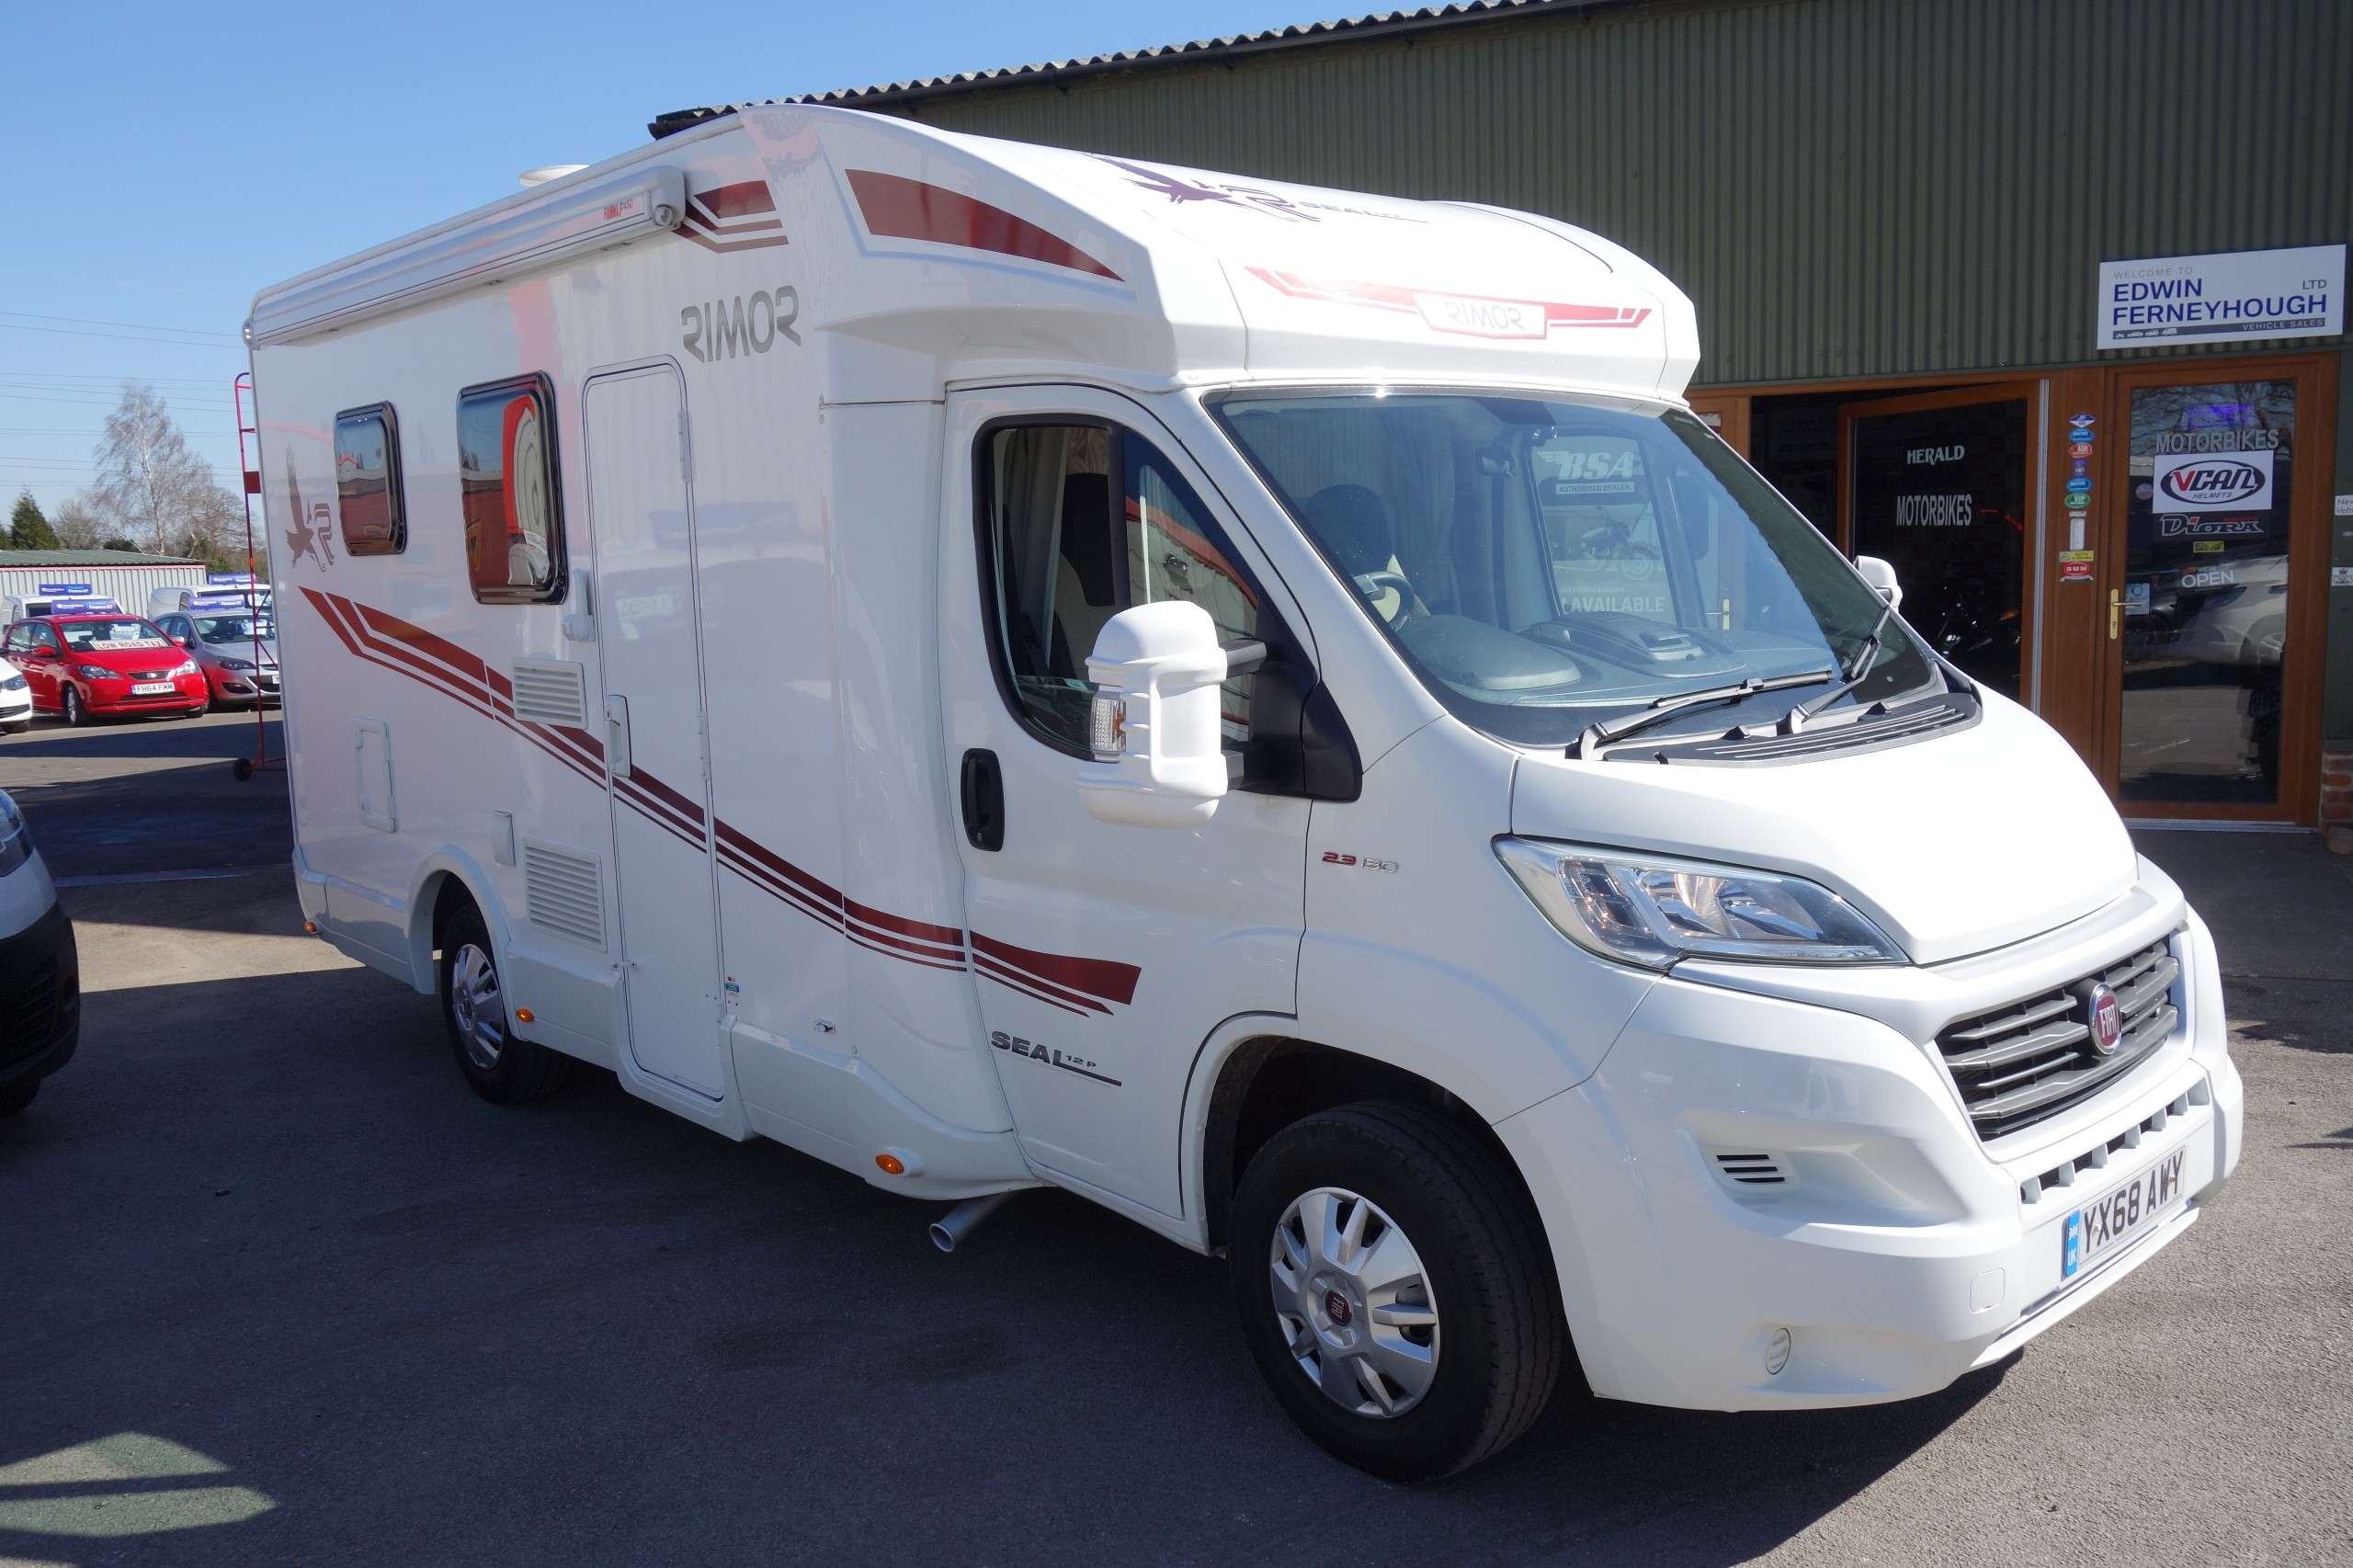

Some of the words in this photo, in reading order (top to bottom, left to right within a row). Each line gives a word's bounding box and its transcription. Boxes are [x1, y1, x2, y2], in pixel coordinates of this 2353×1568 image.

[2114, 267, 2174, 279] WELCOME
[2178, 267, 2193, 275] TO
[2114, 278, 2202, 302] EDWIN
[2302, 279, 2327, 290] LTD
[1444, 301, 1528, 332] RIMOR
[2113, 294, 2327, 325] FERNEYHOUGH
[681, 285, 801, 364] RIMOR
[2243, 321, 2286, 331] VEHICLE
[2290, 318, 2325, 328] SALES
[2155, 427, 2279, 453] MOTORBIKES
[1559, 451, 1634, 480] BSA
[1907, 445, 1965, 465] HERALD
[1559, 484, 1602, 494] AUTHORISED
[1604, 483, 1631, 492] DEALER
[2192, 492, 2234, 500] HELMETS
[1896, 494, 1972, 527] MOTORBIKES
[2181, 570, 2235, 588] OPEN
[1571, 597, 1666, 613] AVAILABLE
[2084, 1181, 2141, 1254] YX68
[2146, 1151, 2184, 1215] AWY
